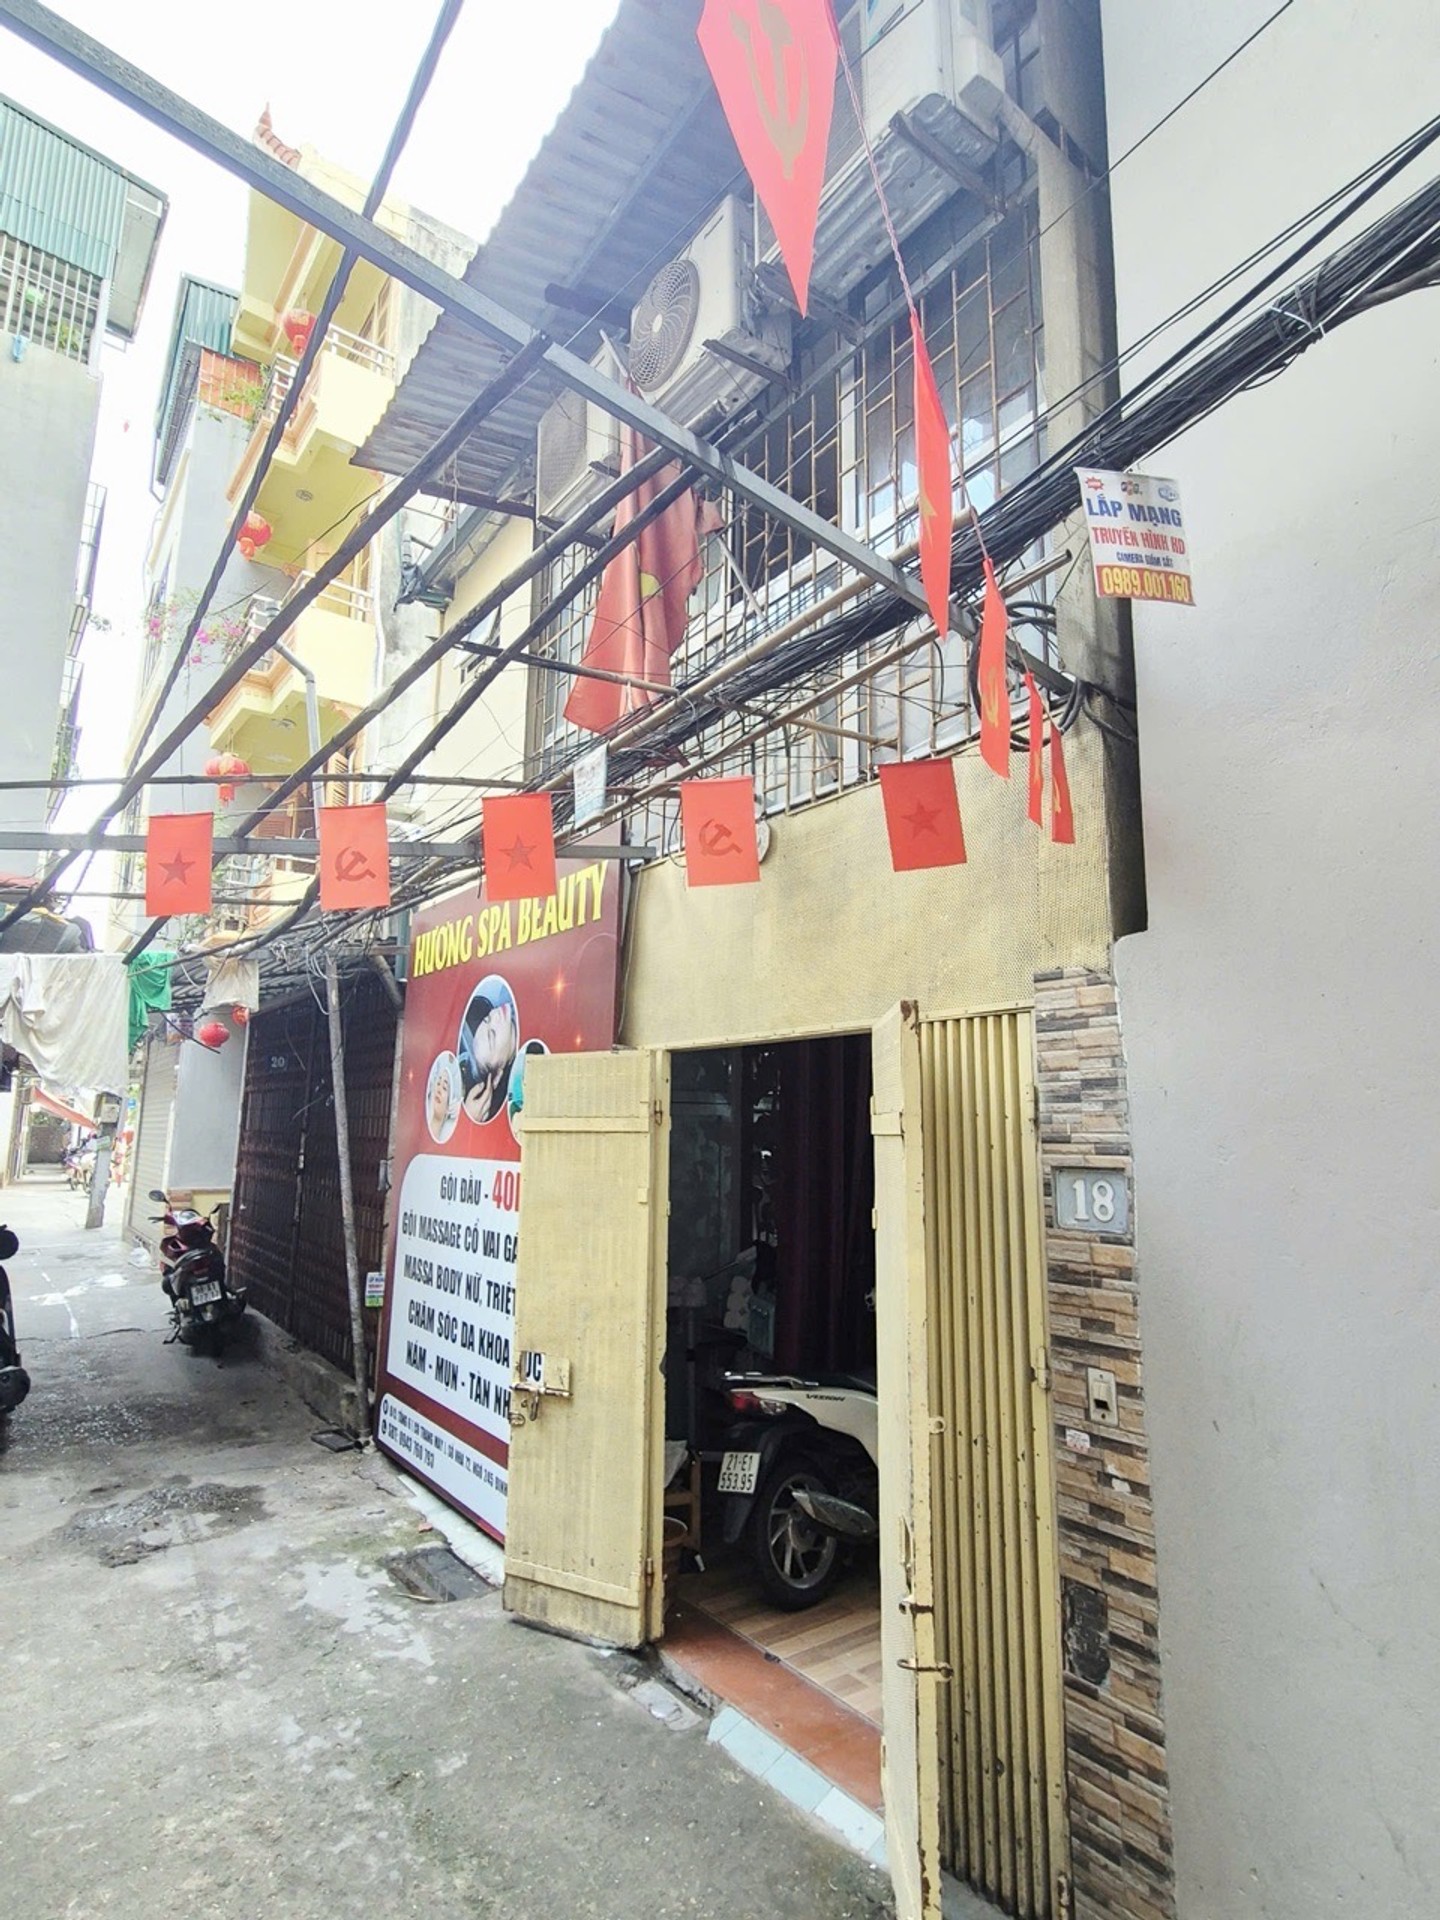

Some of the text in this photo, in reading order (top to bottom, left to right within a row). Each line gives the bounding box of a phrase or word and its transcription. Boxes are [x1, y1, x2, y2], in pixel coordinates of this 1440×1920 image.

[1086, 494, 1183, 527] LẮP MẠNG
[1092, 526, 1186, 555] TRUYỀN HÌNH HD
[1116, 551, 1144, 565] CAMERA
[413, 859, 608, 978] HƯƠNG SPA BEAUTY
[271, 1056, 285, 1068] 20
[440, 1172, 457, 1205] GỘI
[460, 1170, 481, 1206] ĐẦU
[1072, 1179, 1115, 1222] 18
[418, 1215, 461, 1249] MASSAGE
[483, 1229, 500, 1260] VAI
[404, 1254, 433, 1287] MASSA
[437, 1265, 463, 1297] BODY
[437, 1310, 458, 1344] SÓC
[461, 1321, 475, 1352] DA
[479, 1328, 510, 1368] KHOA
[406, 1340, 426, 1374] NÁM
[435, 1355, 459, 1391] MỤN
[469, 1371, 491, 1409] TÀN
[726, 1453, 753, 1472] 21-E1
[720, 1472, 754, 1490] 553.95
